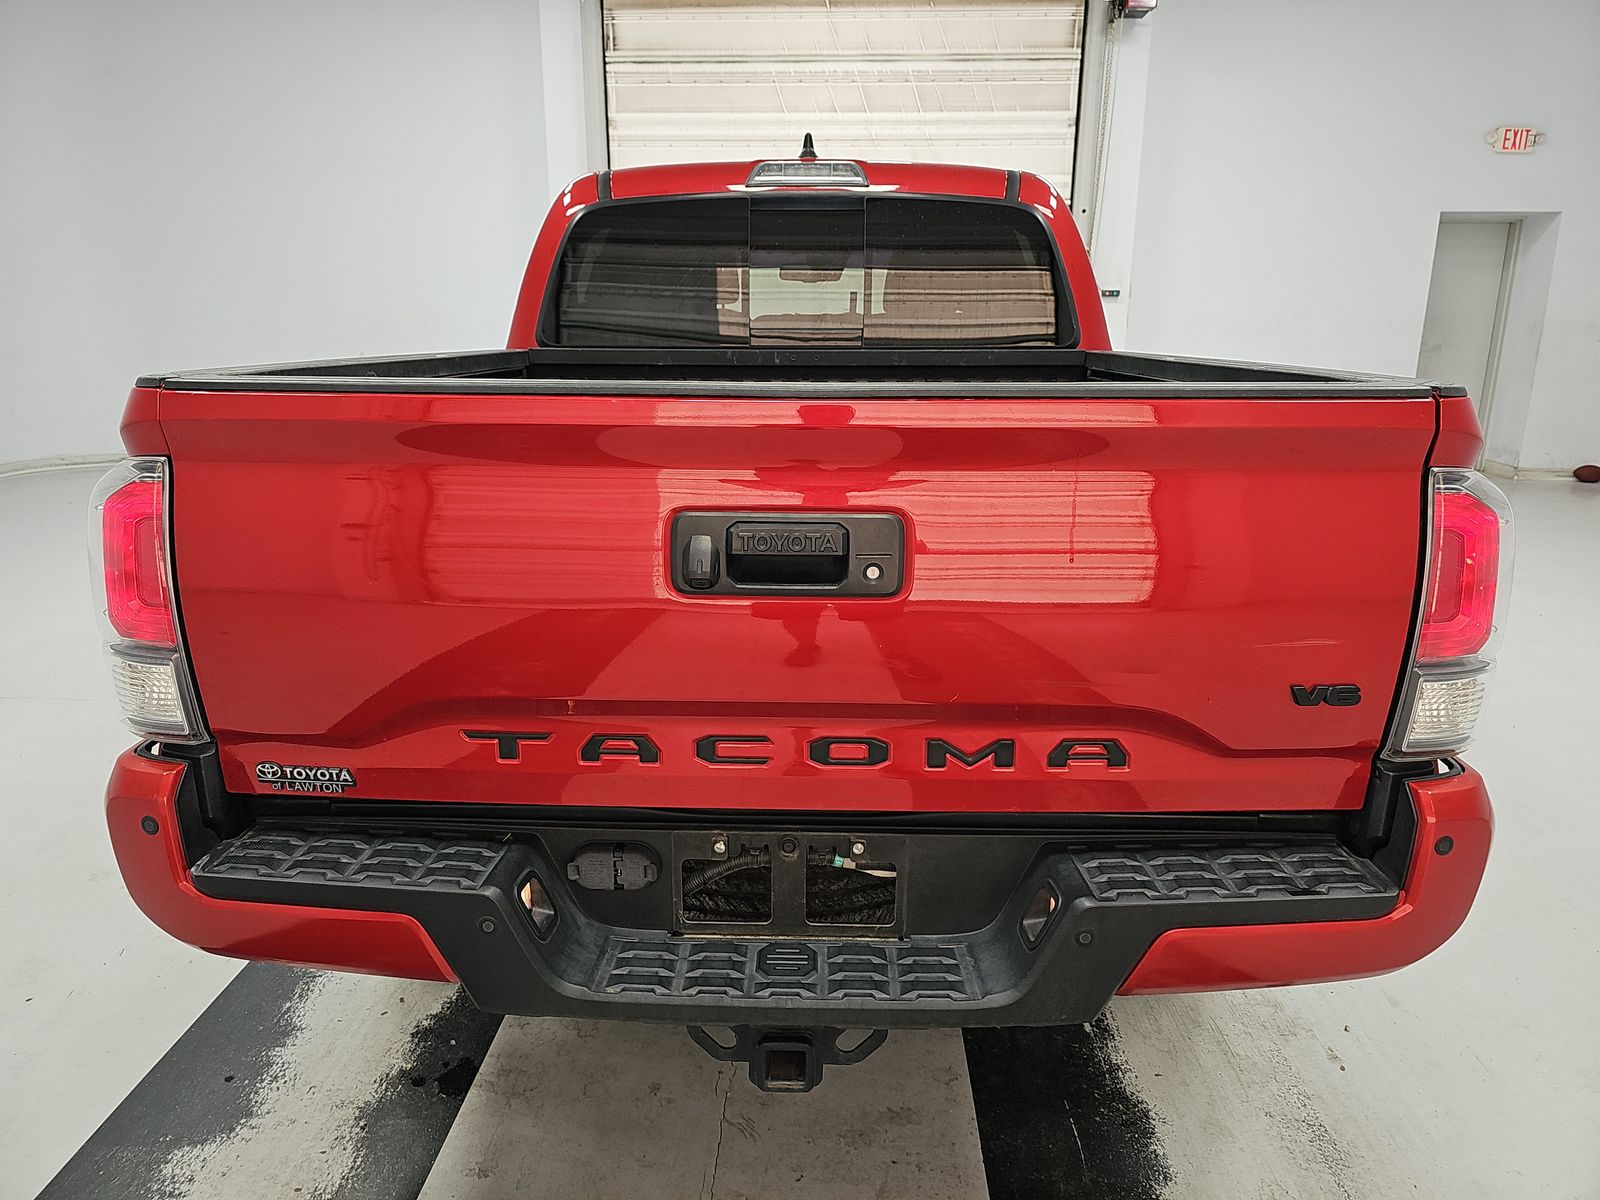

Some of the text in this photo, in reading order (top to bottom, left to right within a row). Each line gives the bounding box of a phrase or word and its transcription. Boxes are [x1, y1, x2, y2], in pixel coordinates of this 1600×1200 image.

[1502, 128, 1532, 150] EXIT
[737, 532, 838, 552] TOYOTA
[1290, 684, 1362, 706] V6
[459, 728, 1131, 771] TACOMA
[282, 766, 353, 782] TOYOTA
[272, 782, 343, 793] of LAWTON
